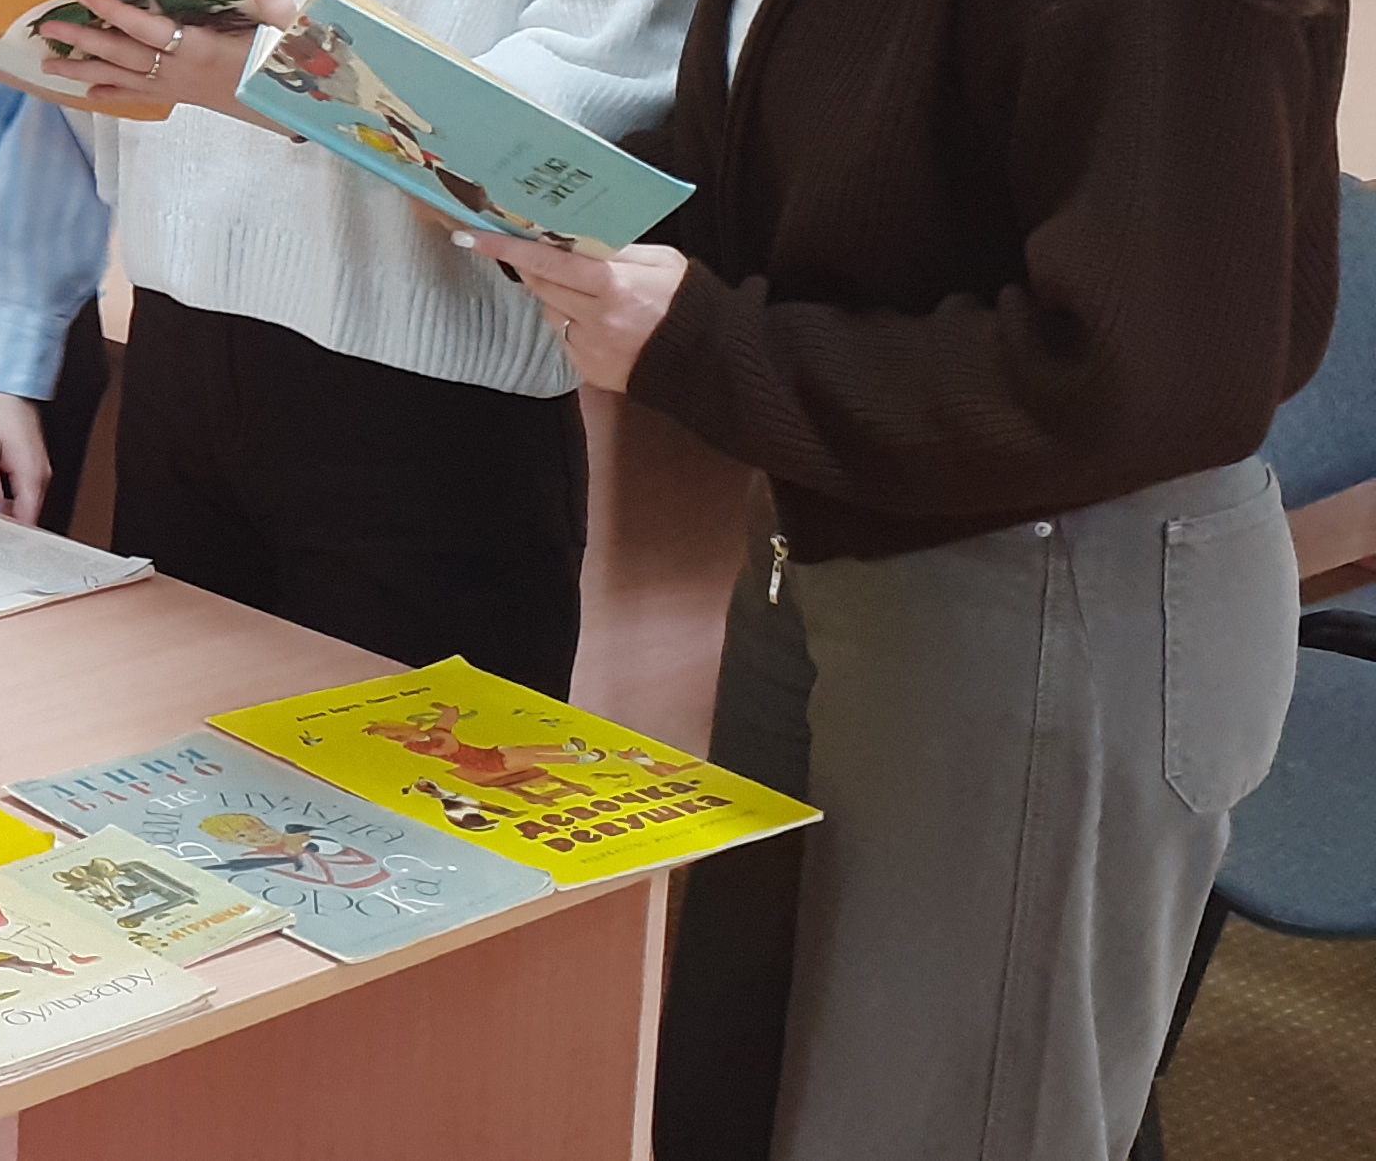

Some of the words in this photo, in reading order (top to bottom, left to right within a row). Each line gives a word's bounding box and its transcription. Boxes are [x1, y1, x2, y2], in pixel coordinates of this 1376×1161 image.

[47, 747, 210, 800] АГНИЯ
[66, 761, 225, 813] БАРТО
[166, 902, 252, 942] ИГРУШКИ
